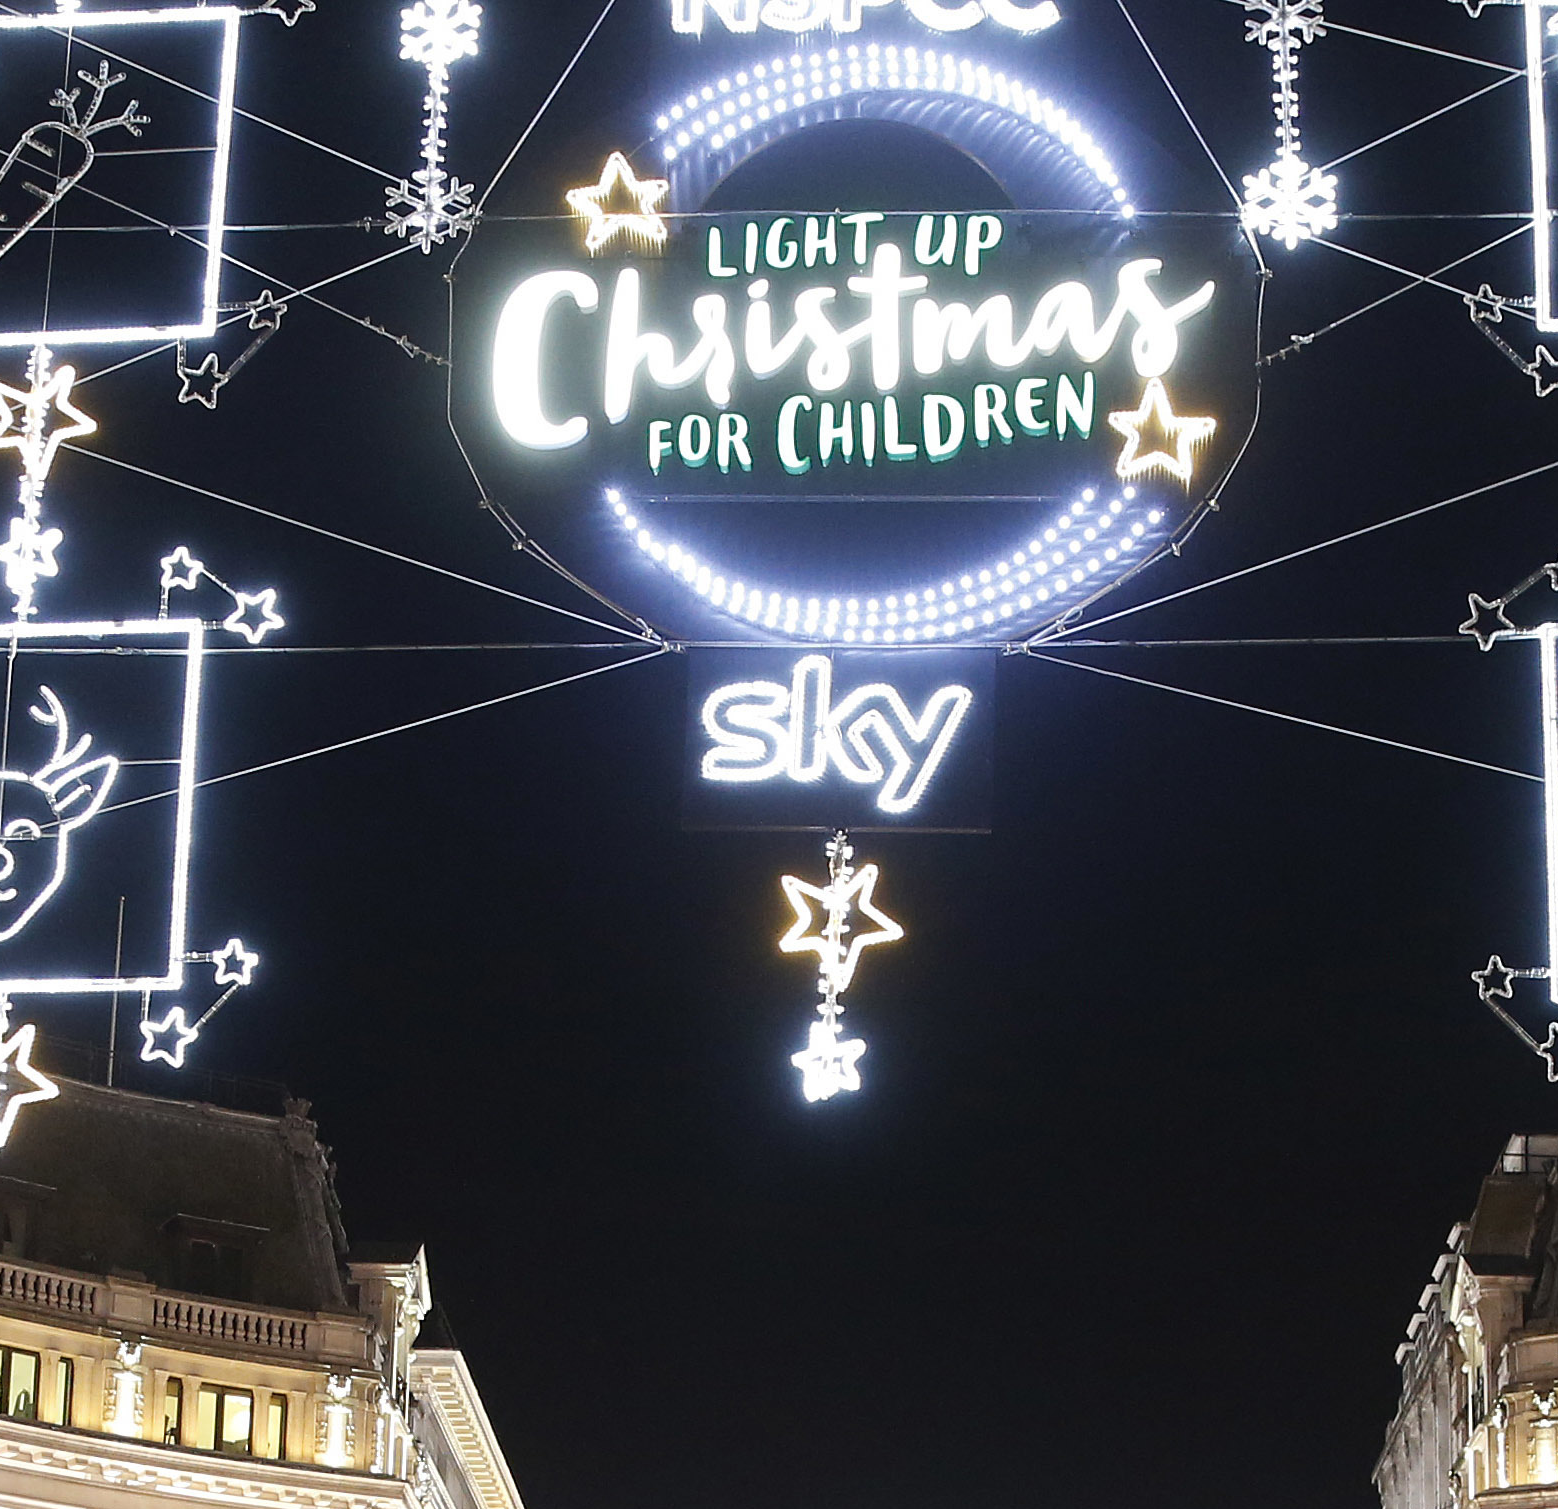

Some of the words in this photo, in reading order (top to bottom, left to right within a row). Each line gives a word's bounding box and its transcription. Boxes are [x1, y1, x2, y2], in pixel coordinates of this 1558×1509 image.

[707, 211, 884, 277] LIGHT
[914, 214, 1005, 275] UP
[492, 243, 1216, 449] Christmas
[648, 412, 753, 475] FOR
[776, 370, 1097, 475] CHILDREN
[700, 654, 974, 814] sky
